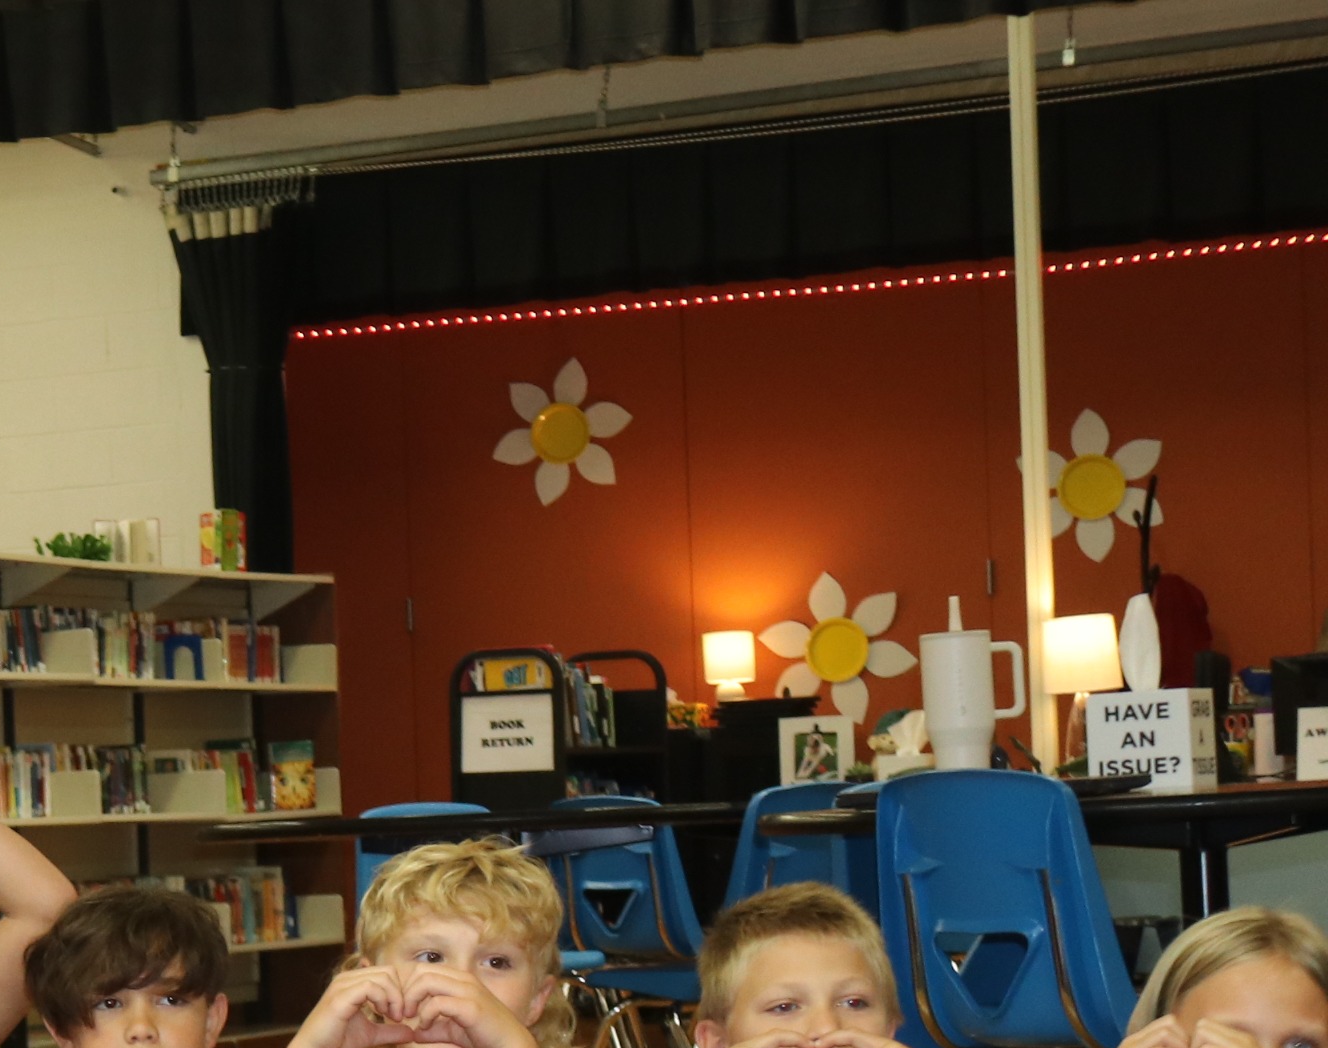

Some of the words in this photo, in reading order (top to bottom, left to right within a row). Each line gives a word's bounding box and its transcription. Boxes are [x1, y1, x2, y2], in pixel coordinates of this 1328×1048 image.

[1104, 702, 1170, 722] HAVE
[489, 719, 525, 730] BOOK
[481, 736, 534, 748] RETURN
[1121, 730, 1156, 749] AN
[1099, 756, 1182, 777] ISSUE?
